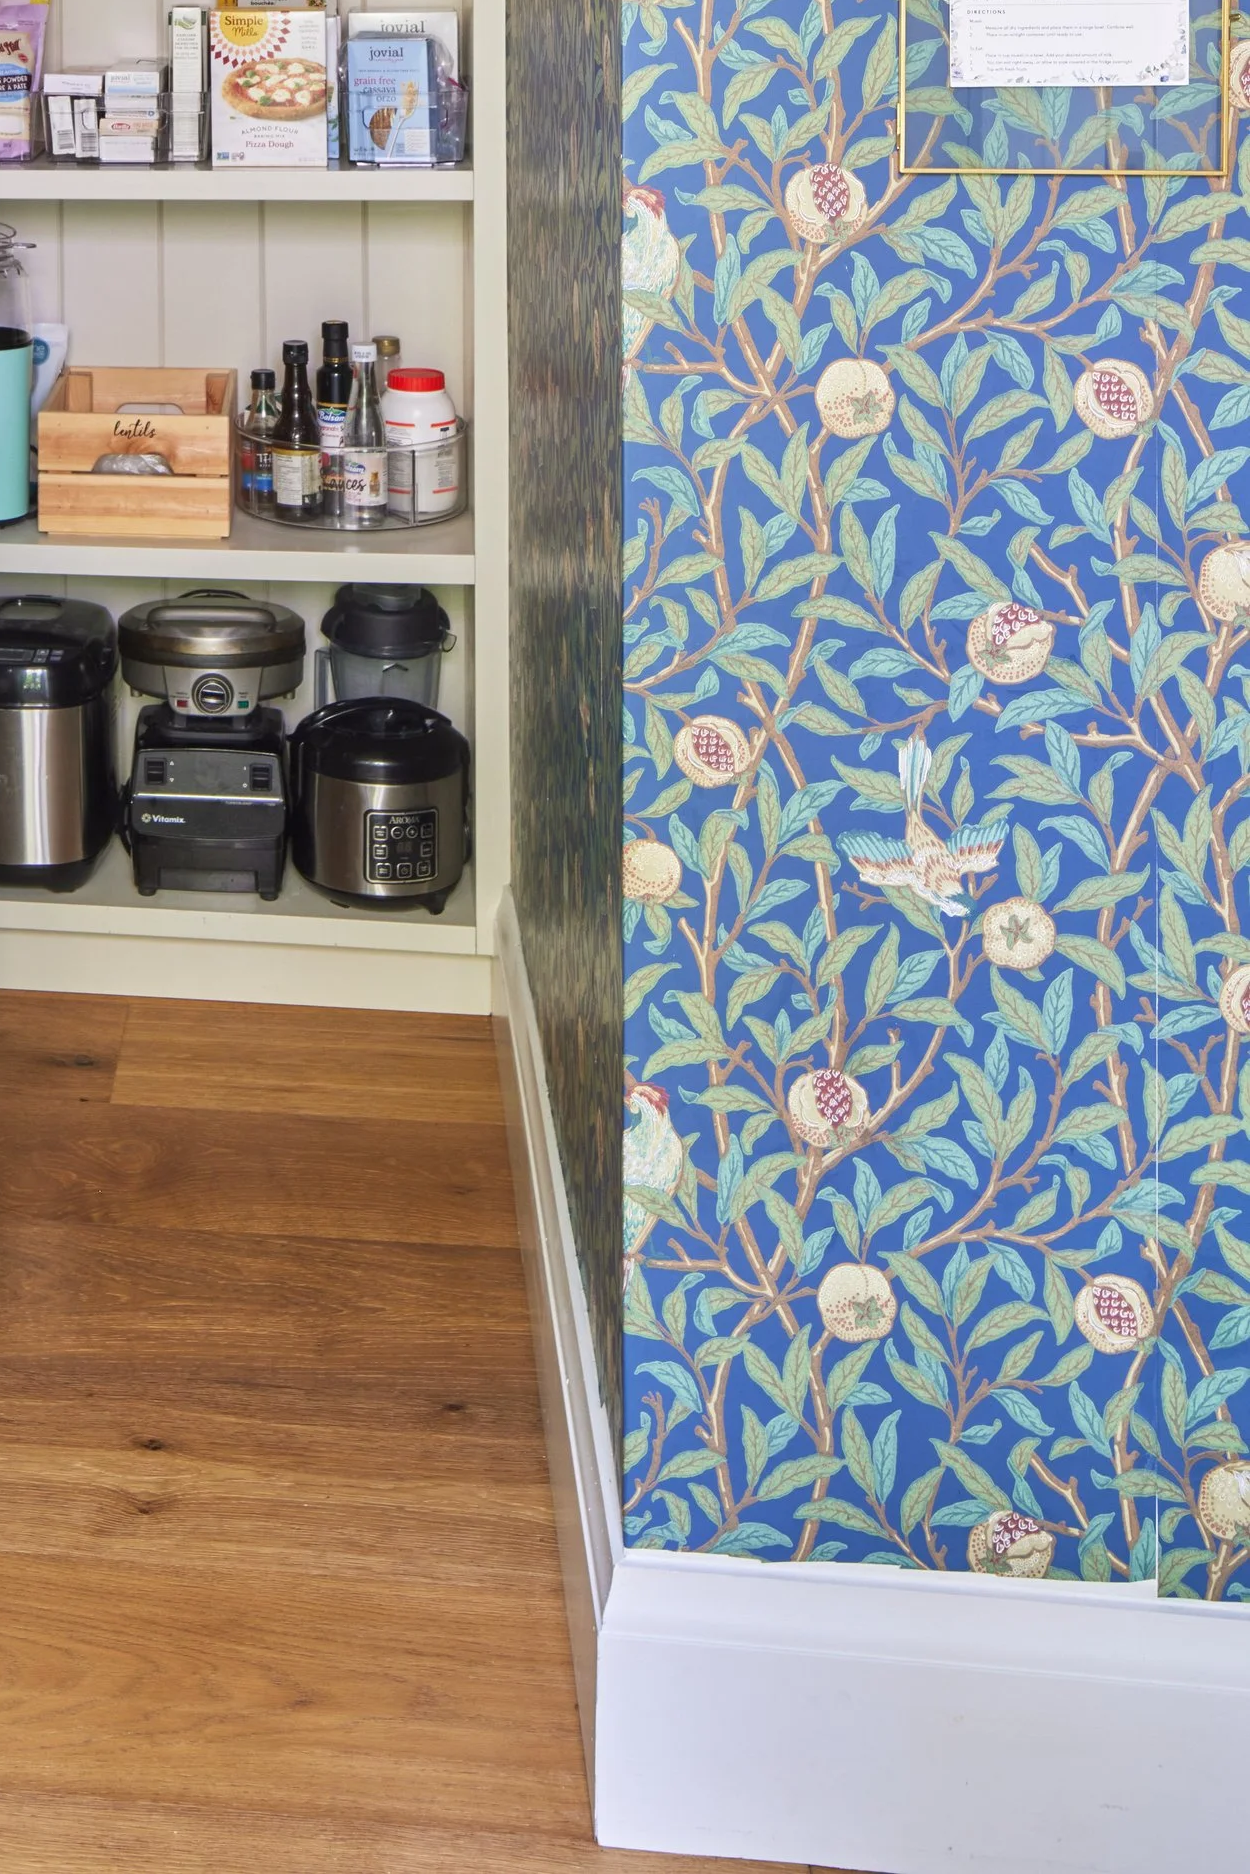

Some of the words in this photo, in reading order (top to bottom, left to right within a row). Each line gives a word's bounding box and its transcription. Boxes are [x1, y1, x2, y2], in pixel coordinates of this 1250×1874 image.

[224, 15, 264, 27] Simple
[380, 18, 427, 33] jovial
[231, 27, 259, 37] Mills
[368, 45, 404, 62] jovial
[3, 75, 29, 83] POWDER
[353, 76, 377, 87] grain
[378, 76, 396, 85] free
[362, 86, 397, 94] cassava
[375, 95, 397, 103] orzo
[241, 125, 273, 135] ALMOND
[275, 125, 299, 135] FLOUR
[245, 140, 266, 148] Pizza
[268, 140, 295, 150] Dough
[114, 419, 157, 440] lentils
[152, 813, 186, 824] Vitamix
[390, 815, 420, 825] AROMA
